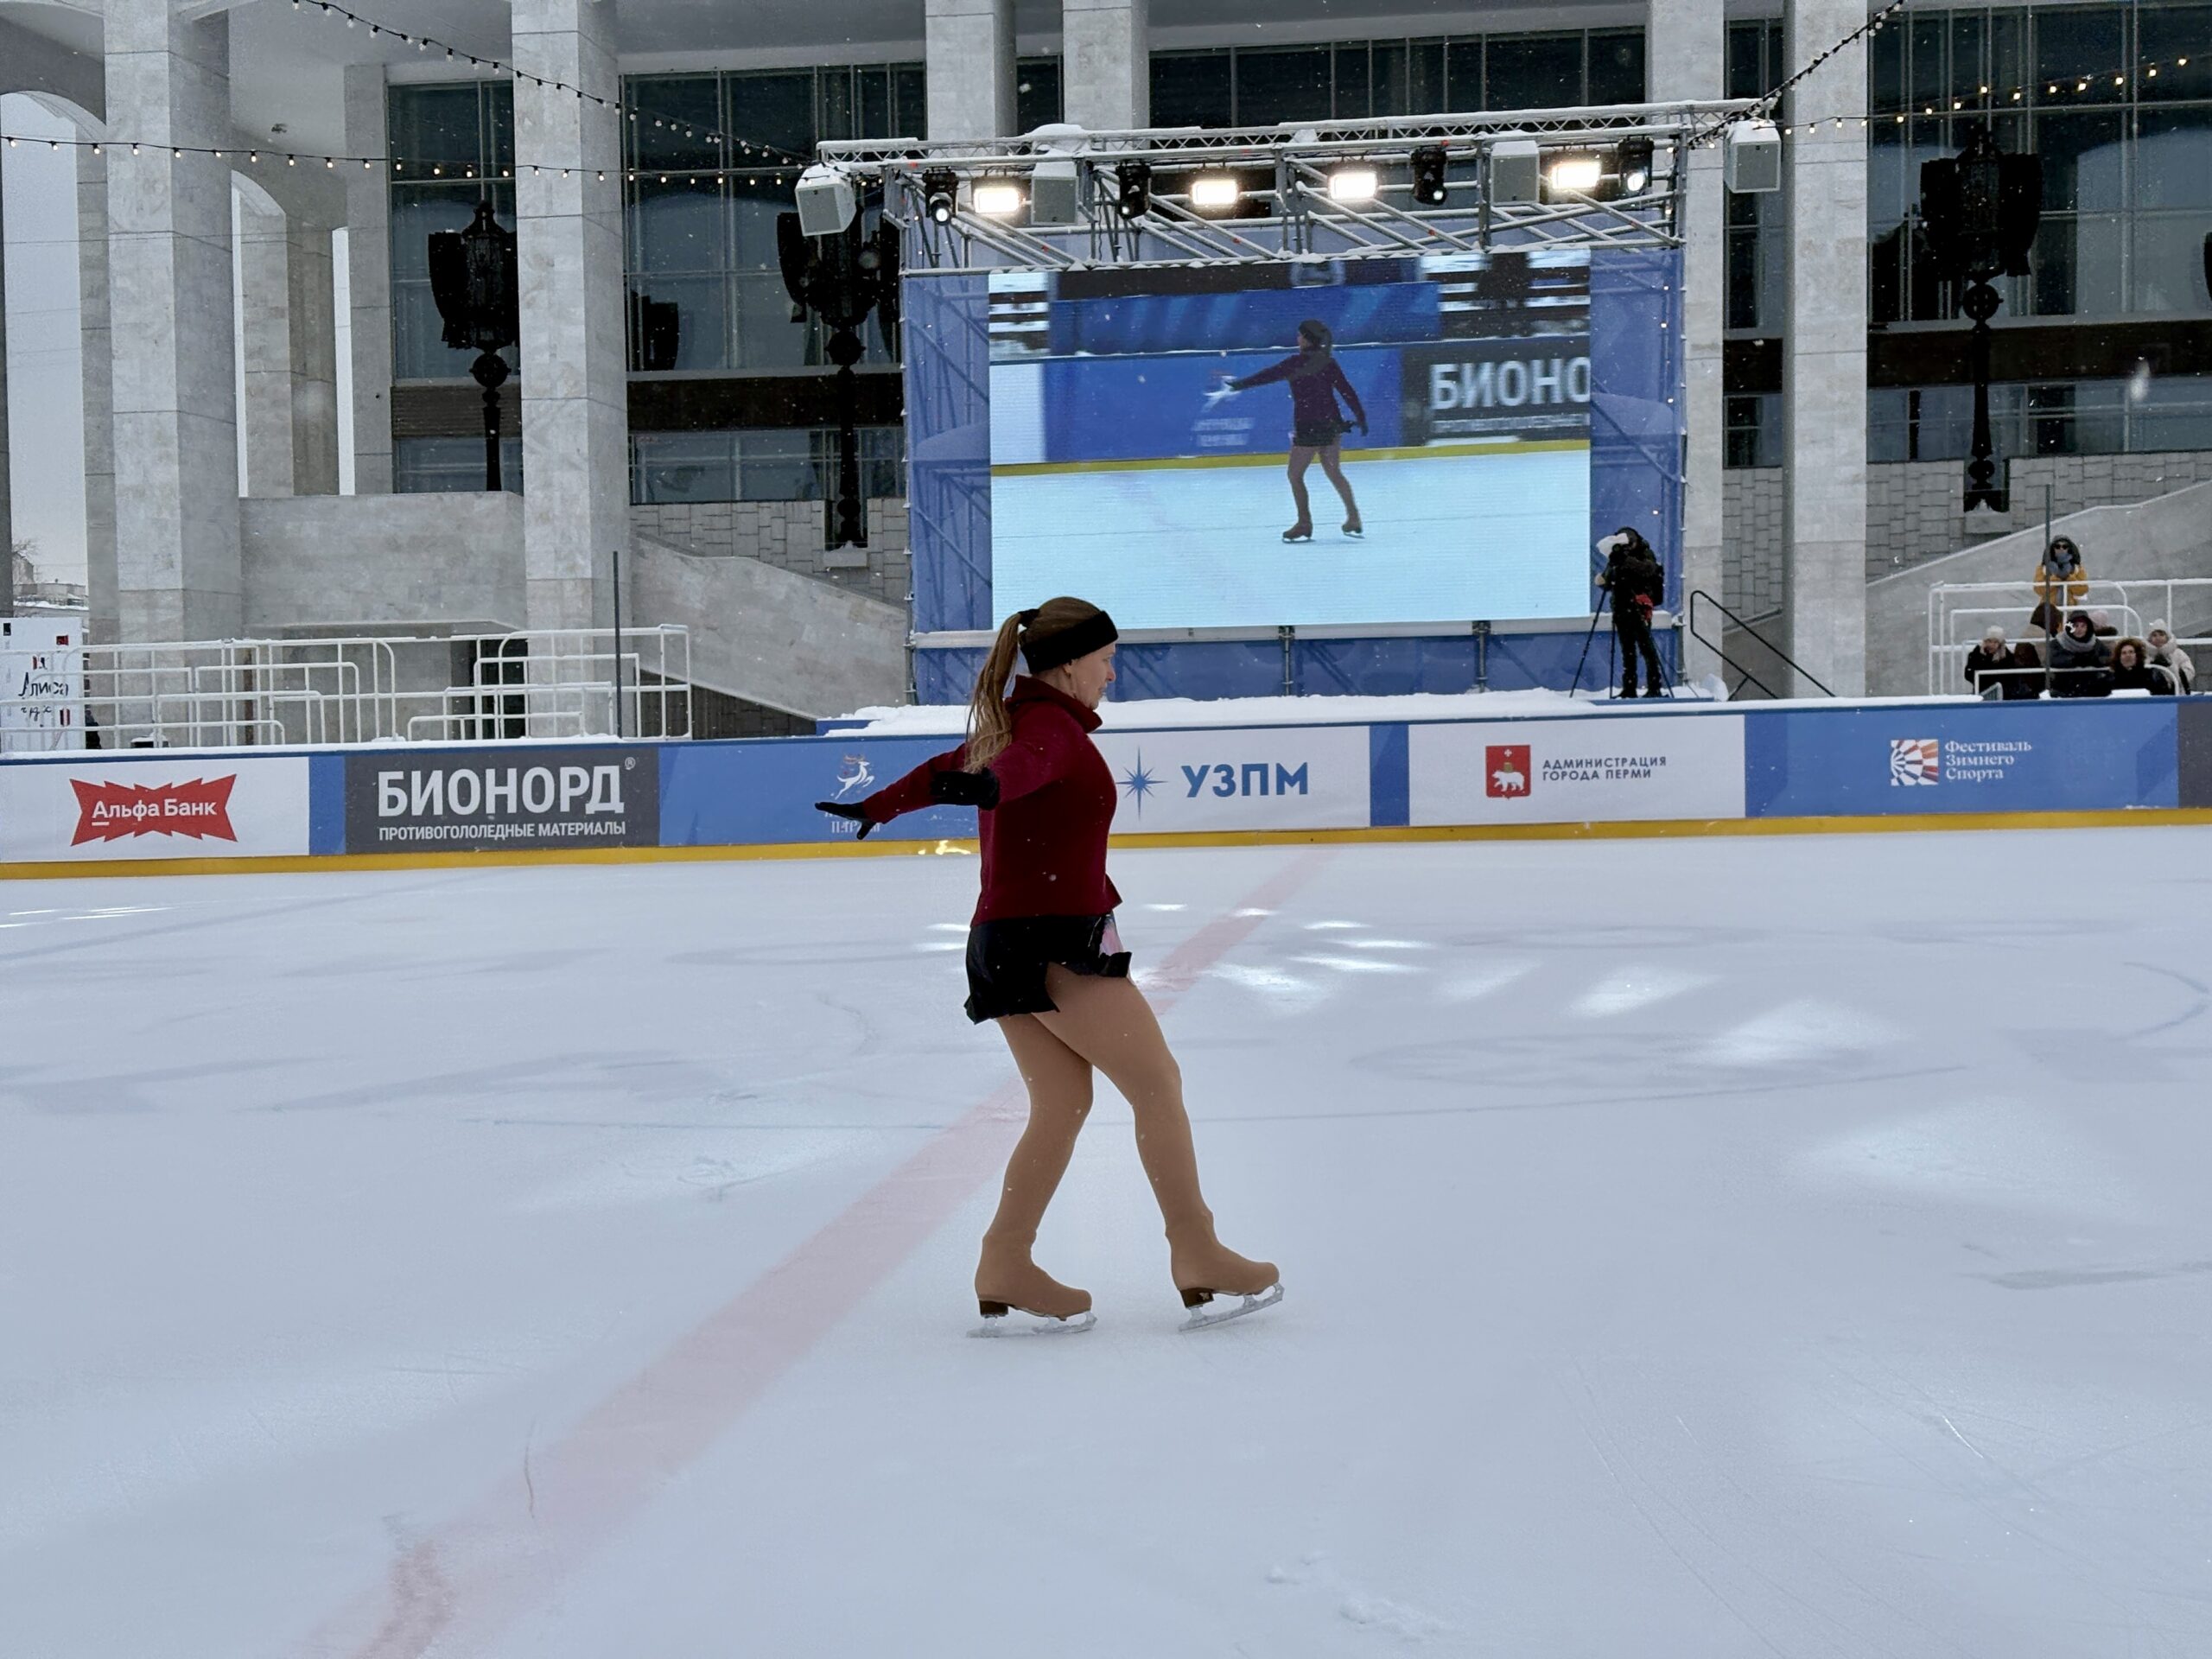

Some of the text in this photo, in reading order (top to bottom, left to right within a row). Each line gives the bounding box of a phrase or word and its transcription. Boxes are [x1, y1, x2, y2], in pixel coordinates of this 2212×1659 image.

[1944, 741, 2032, 753] Фестиваль
[1542, 756, 1667, 770] АДМИНИСТРАЦИЯ
[1945, 753, 2015, 766] Зимнего
[1180, 762, 1308, 798] УЗПМ
[1542, 769, 1651, 781] ГОРОДА ПЕРМИ
[1946, 767, 2004, 782] Спорта
[92, 798, 217, 821] Альфа Банк
[378, 821, 626, 841] ПРОТИВОГОЛОЛЕДНЫЕ МАТЕРИАЛЫ
